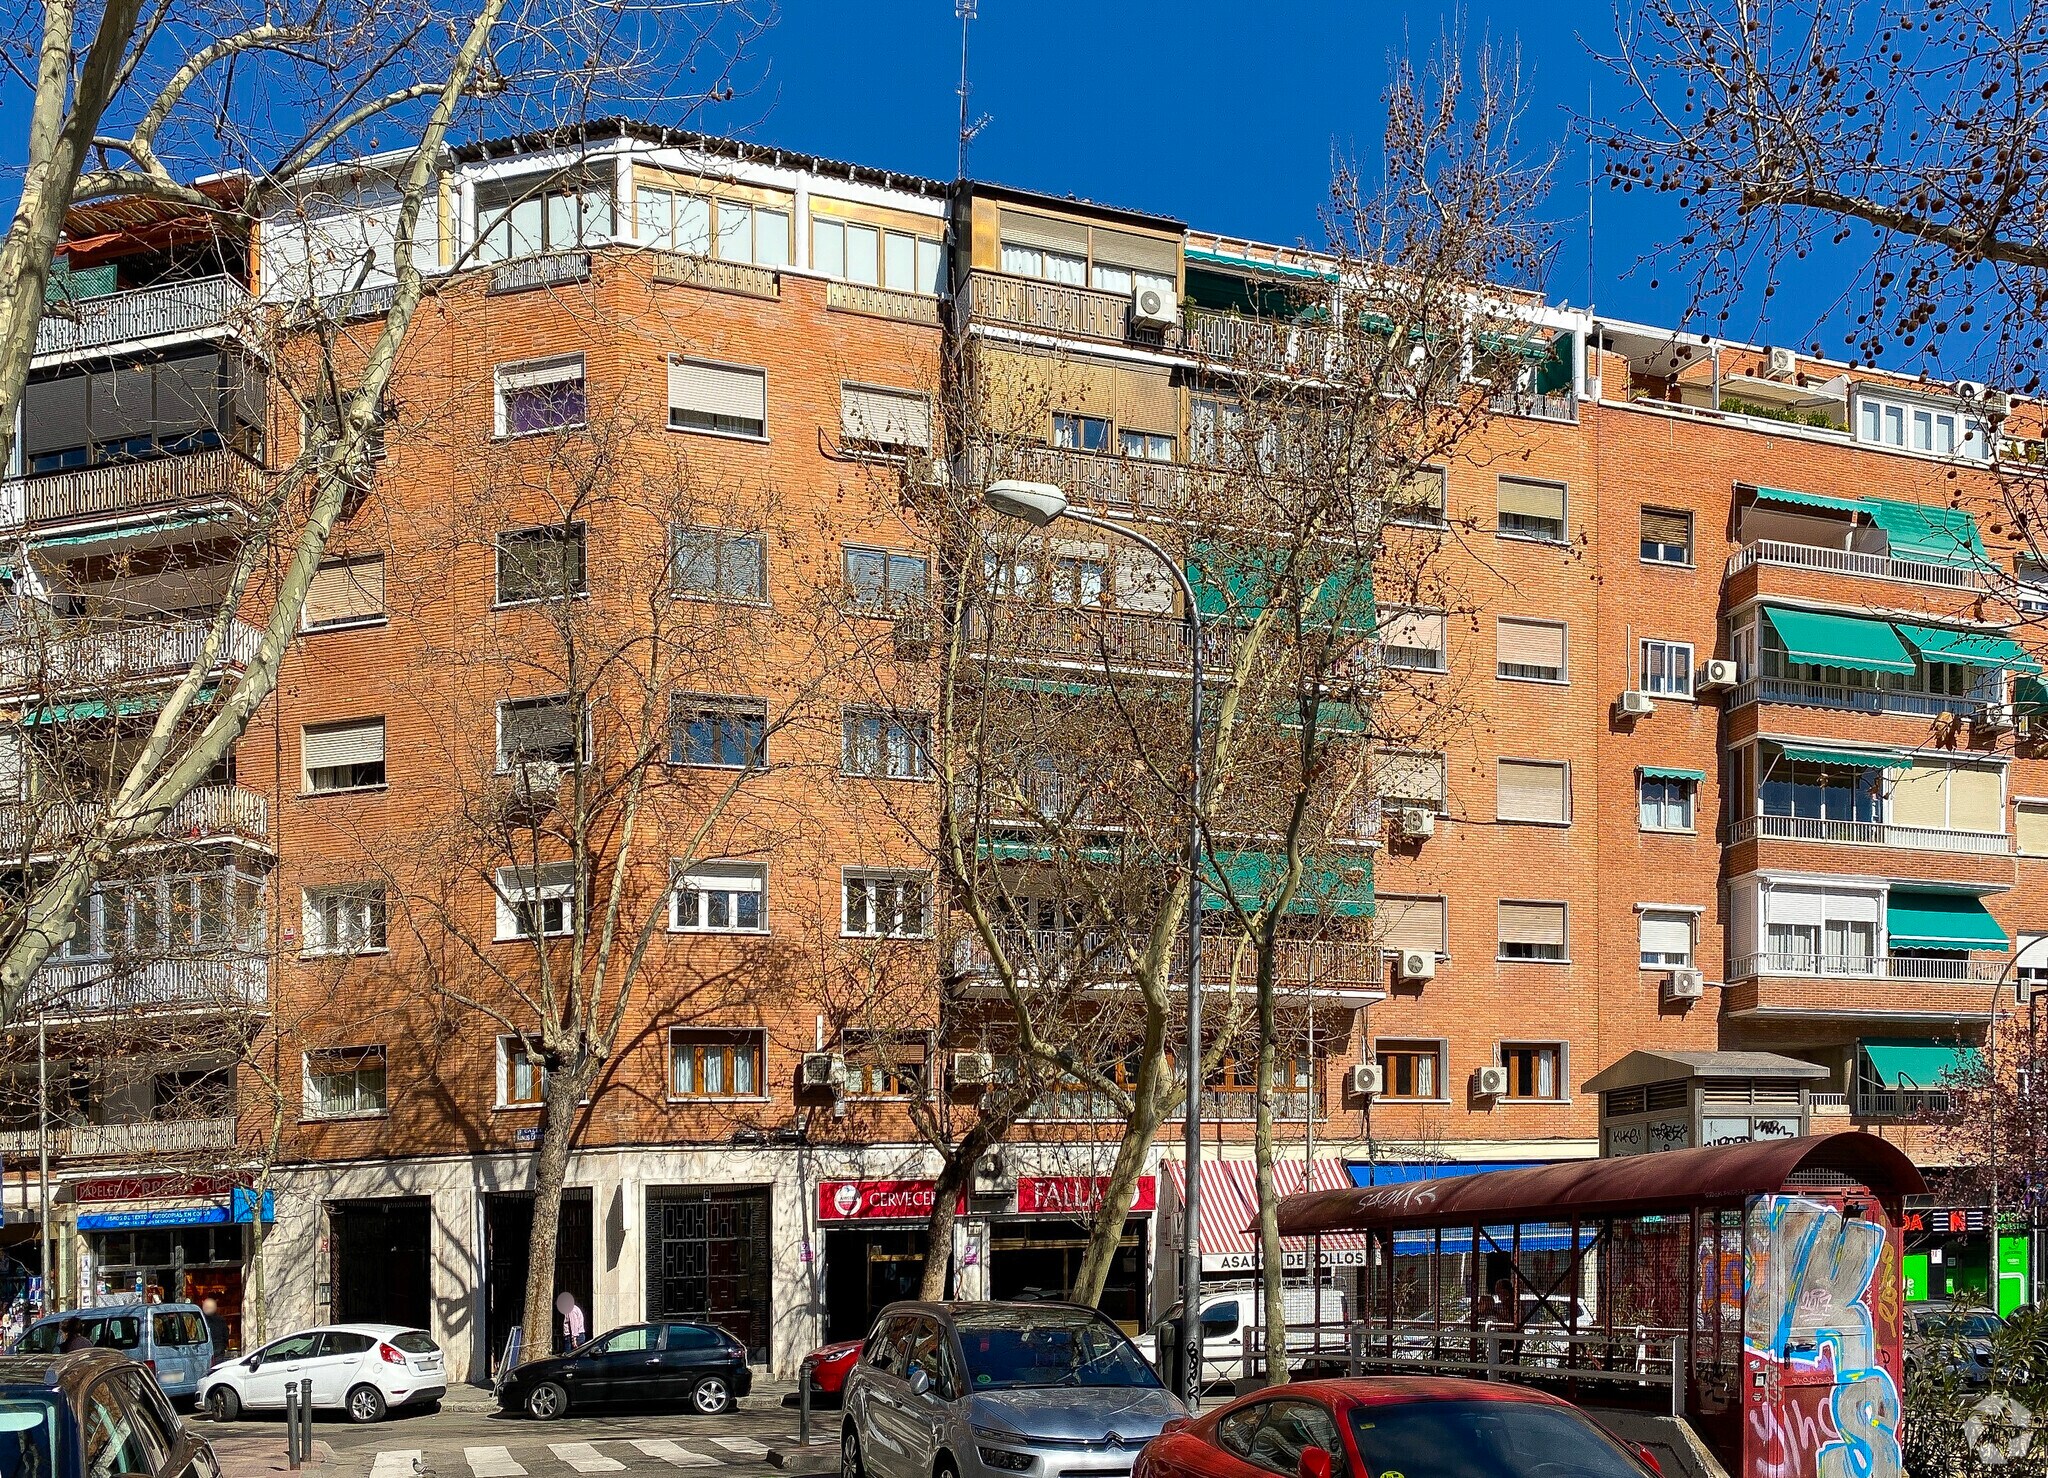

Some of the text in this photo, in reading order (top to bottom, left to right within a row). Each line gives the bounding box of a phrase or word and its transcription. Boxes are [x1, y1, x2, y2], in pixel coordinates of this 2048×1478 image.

[869, 1191, 937, 1207] CERVECER
[1286, 1255, 1303, 1266] DE
[1310, 1252, 1364, 1265] OLLOS
